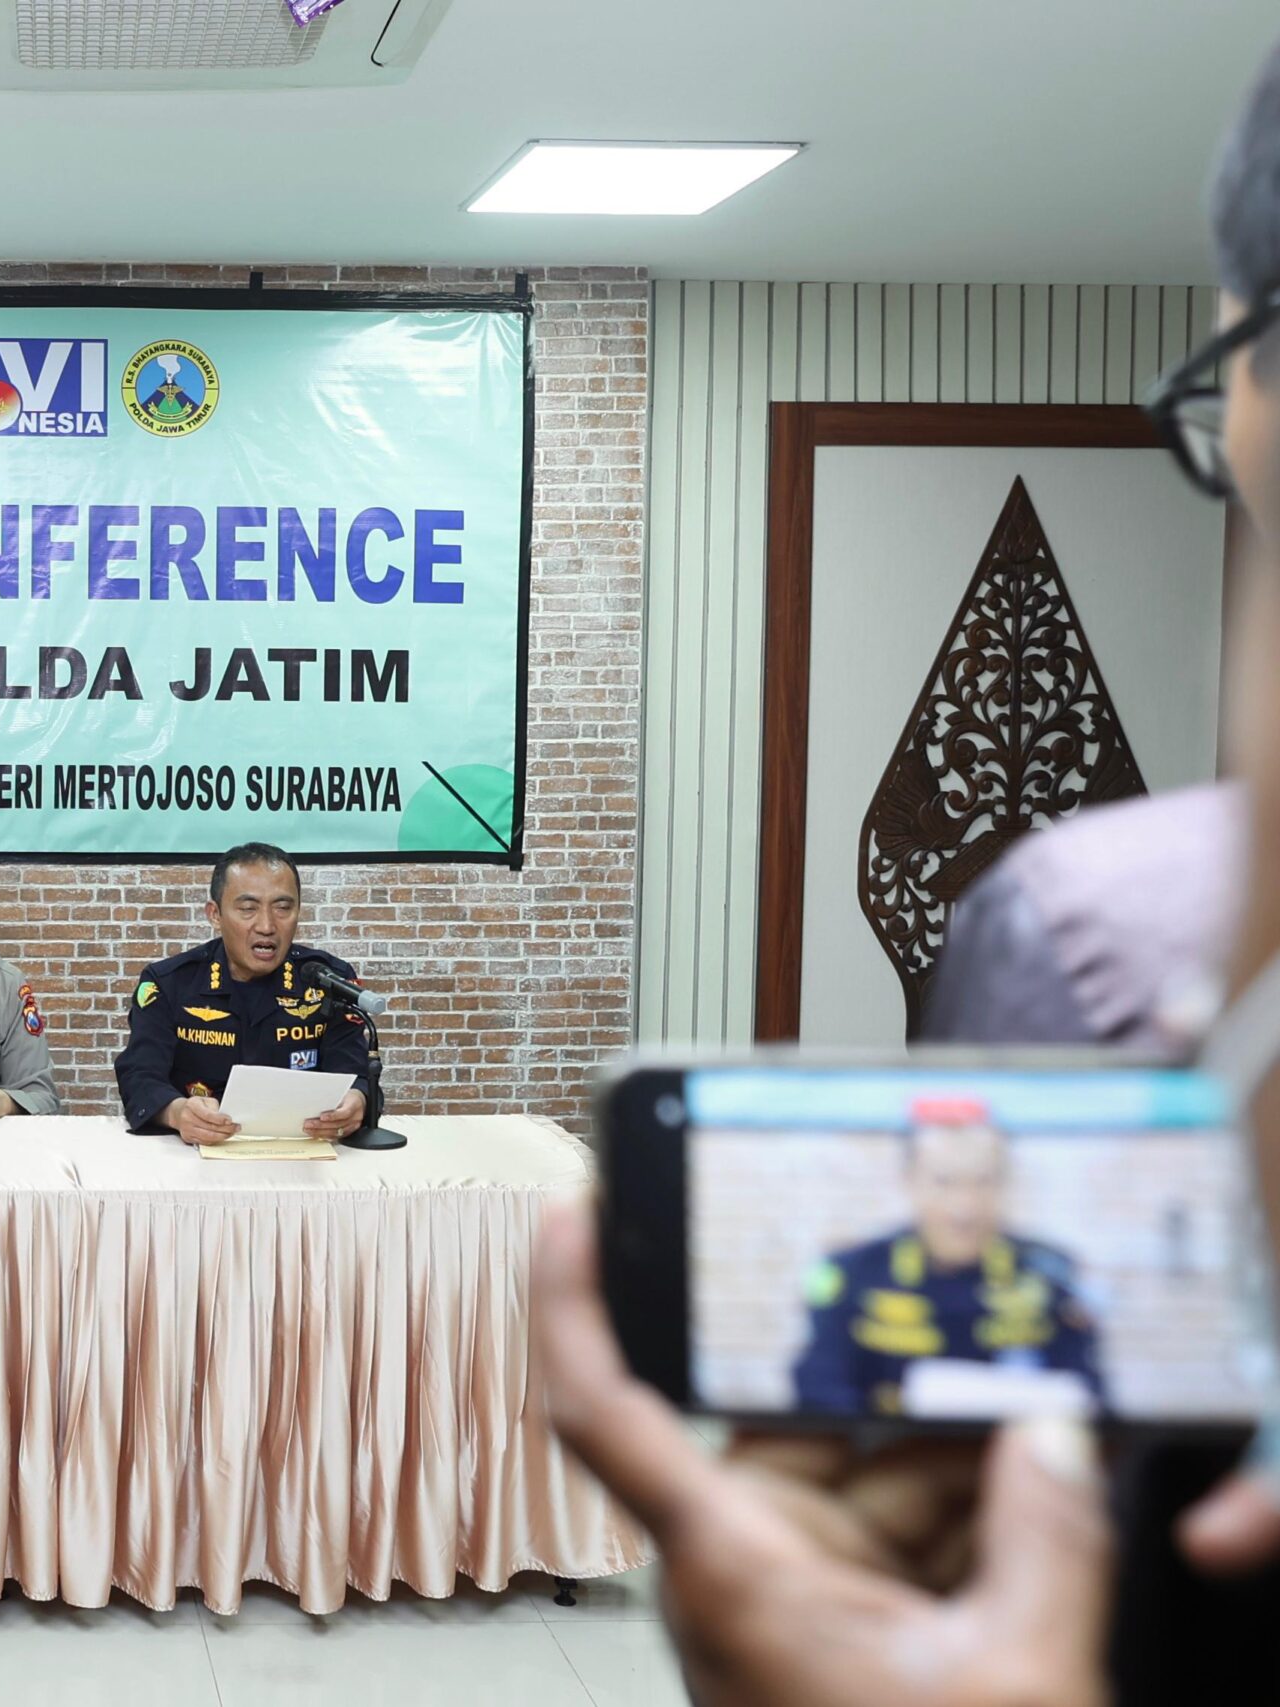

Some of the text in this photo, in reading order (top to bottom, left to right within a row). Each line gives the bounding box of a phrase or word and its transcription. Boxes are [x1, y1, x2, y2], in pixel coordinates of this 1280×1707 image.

[133, 343, 187, 369] BHAYANGKARA
[187, 349, 215, 385] SURABAYA
[129, 402, 212, 434] POLDA JAWA TIMUR
[170, 647, 410, 703] JATIM
[53, 764, 236, 812] MERTOJOSO
[245, 765, 402, 812] SURABAYA
[177, 1026, 236, 1047] M.KHUSNAN
[290, 1050, 316, 1065] DVI
